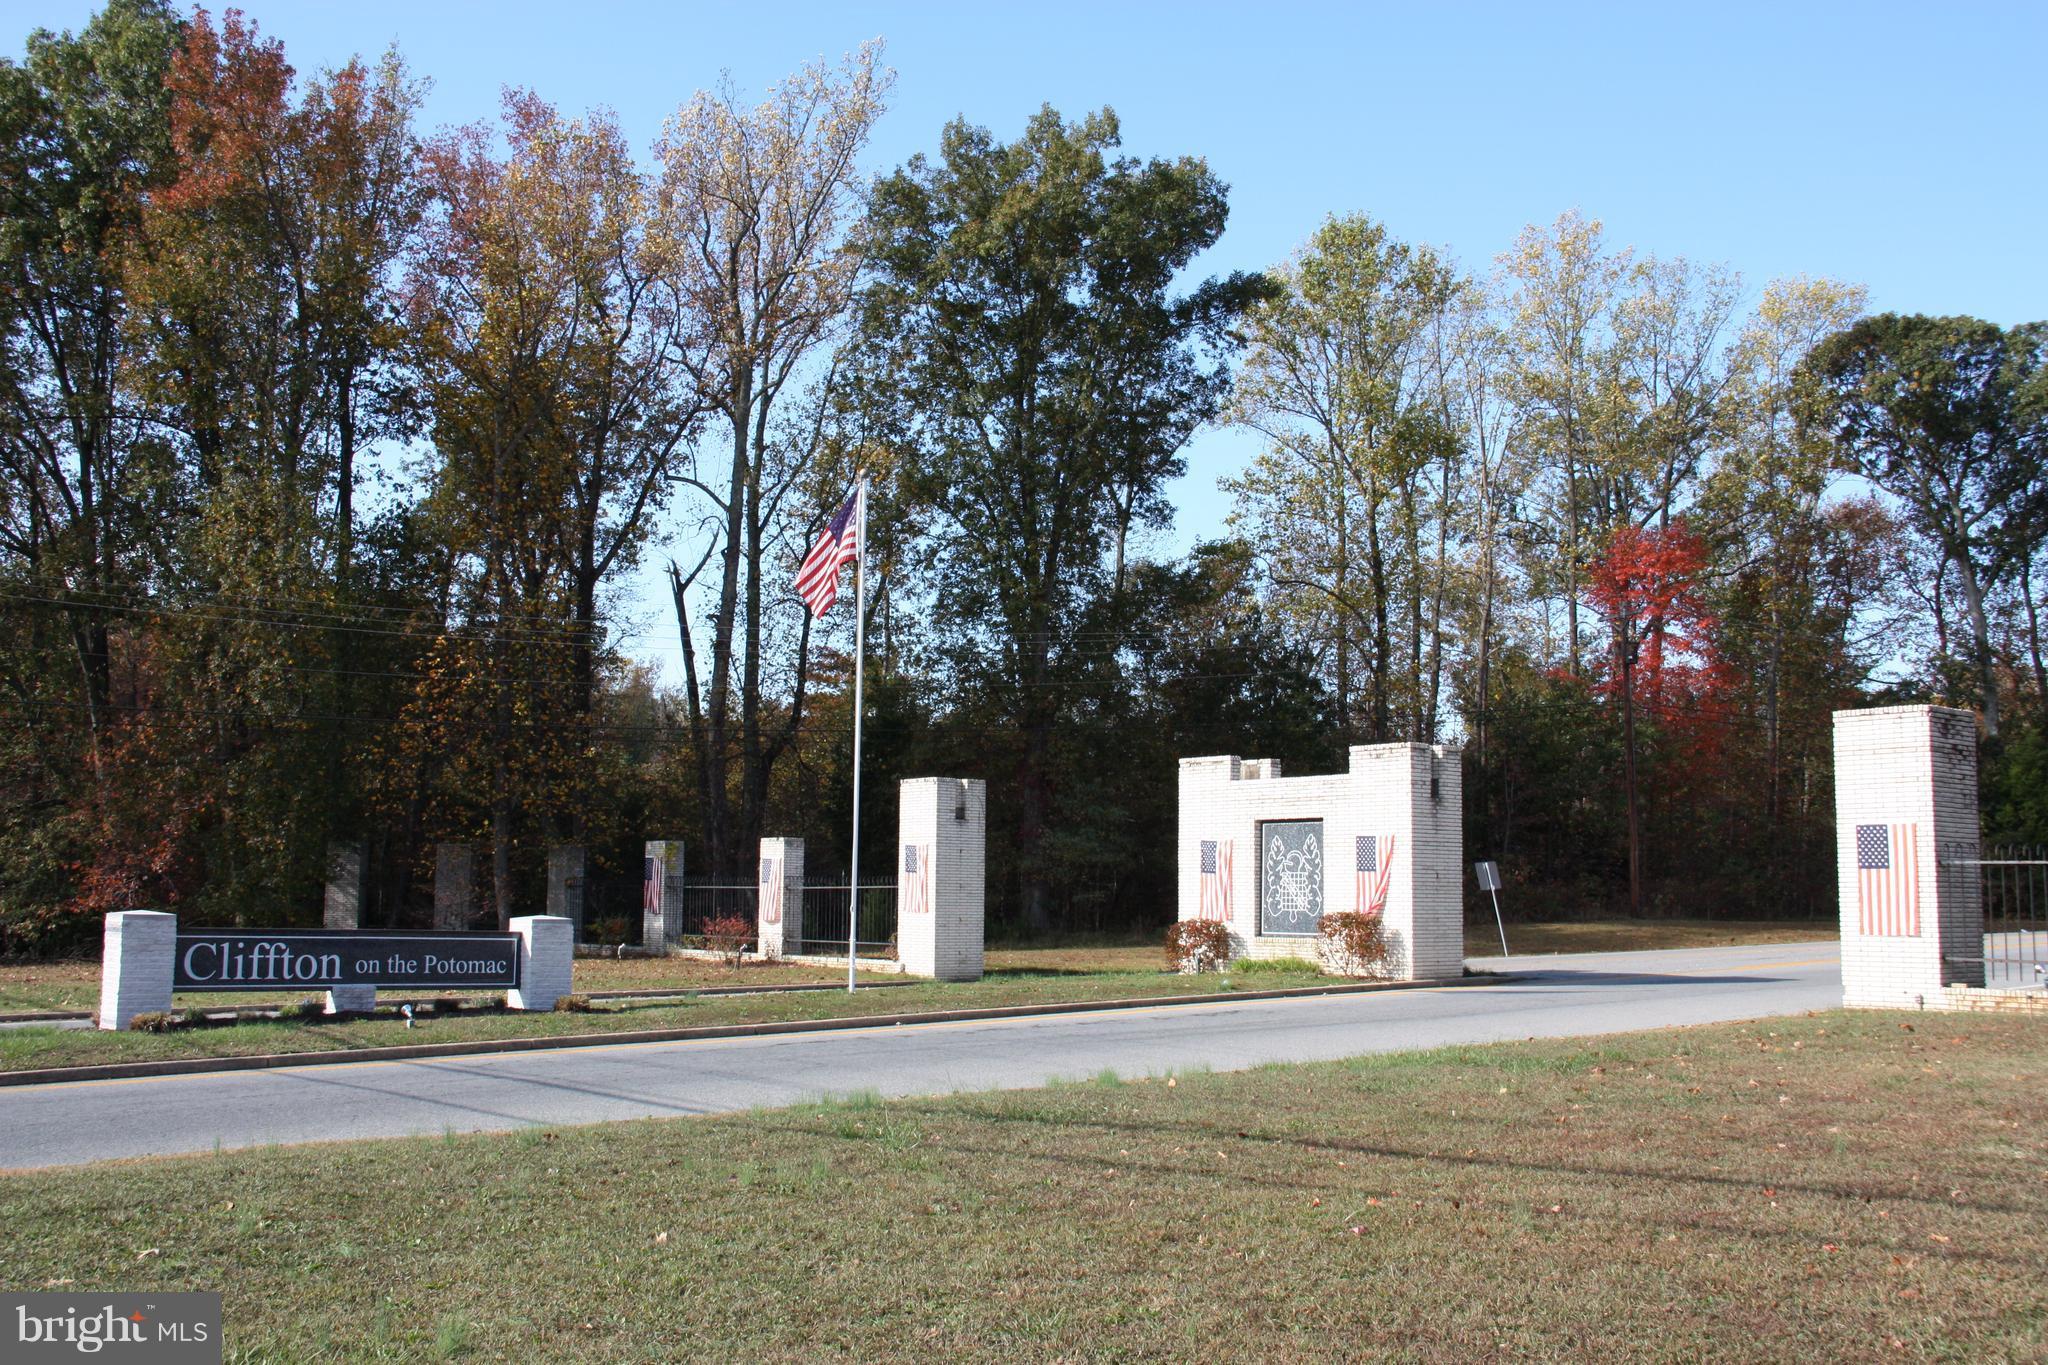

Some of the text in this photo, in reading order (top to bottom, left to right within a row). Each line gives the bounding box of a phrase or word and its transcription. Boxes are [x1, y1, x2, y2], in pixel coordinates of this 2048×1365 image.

[183, 941, 506, 981] Cliffton on the Potomac
